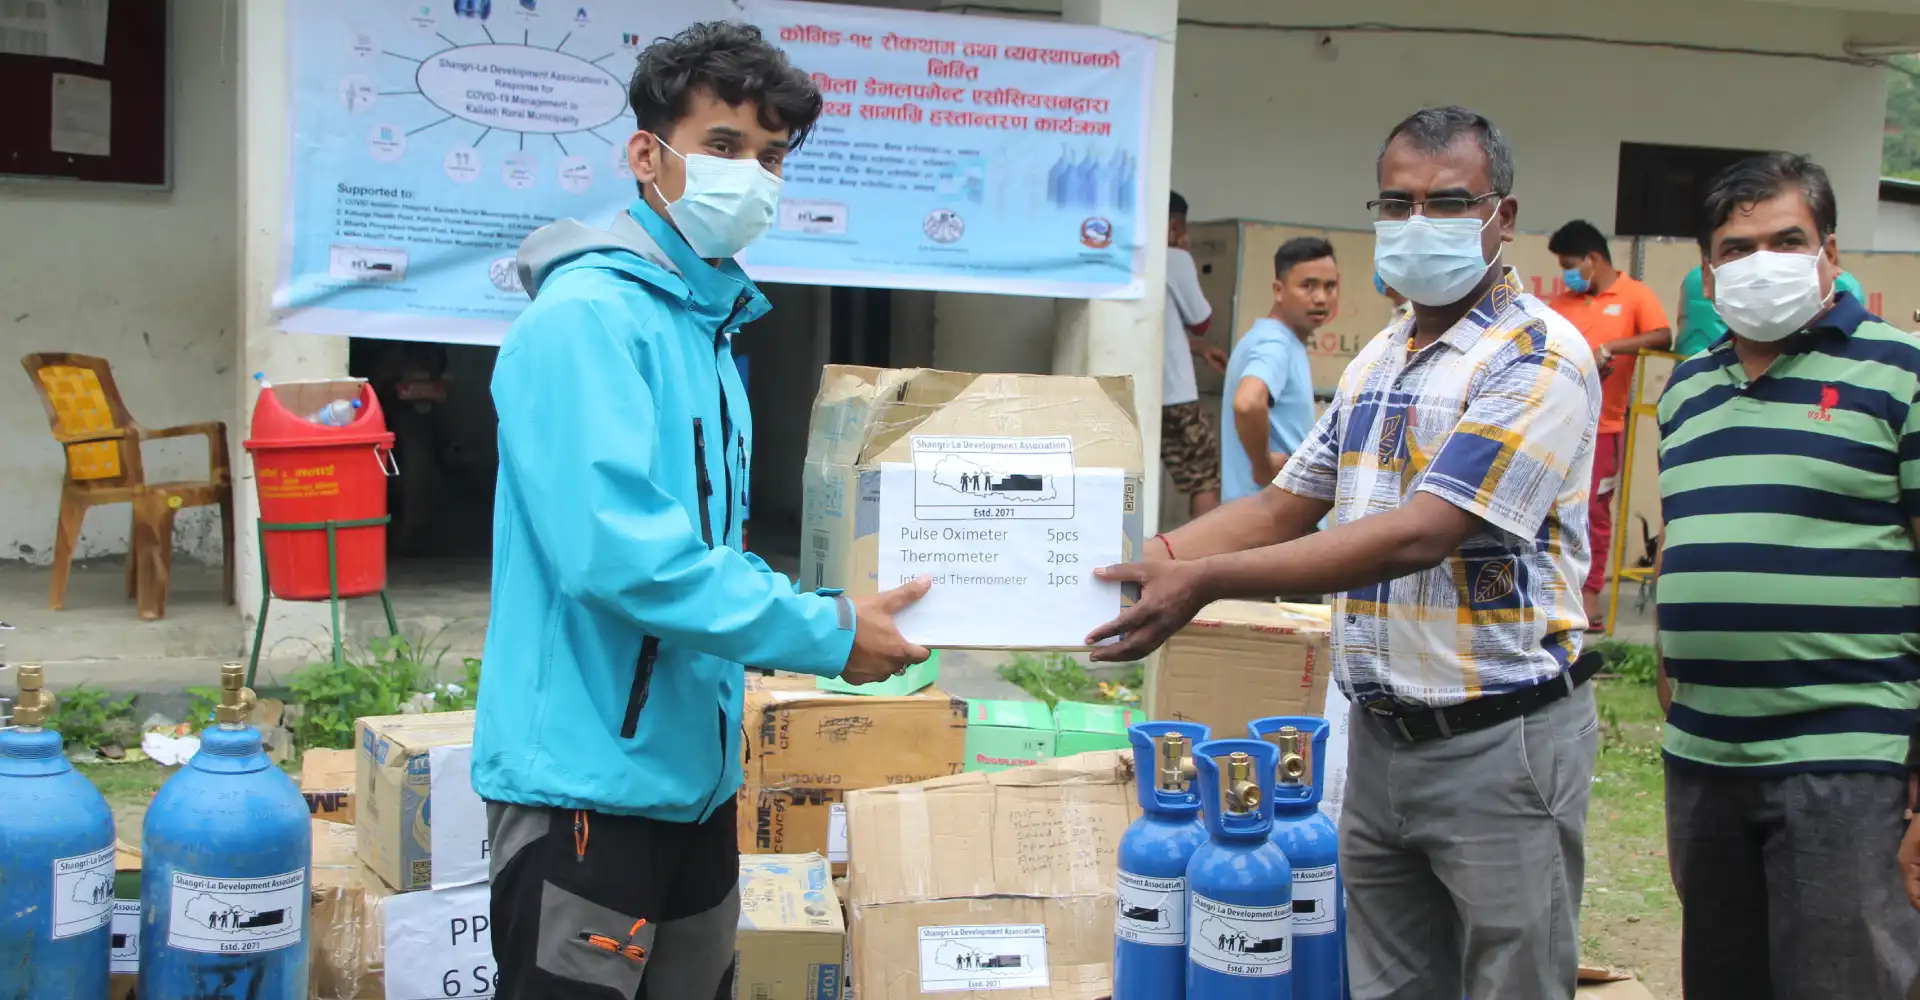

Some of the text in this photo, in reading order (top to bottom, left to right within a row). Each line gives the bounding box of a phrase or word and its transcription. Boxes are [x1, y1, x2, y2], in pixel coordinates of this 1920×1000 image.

[881, 32, 956, 55] रोकथाम
[963, 42, 998, 60] तथा
[439, 58, 488, 73] Shangri-La
[490, 65, 549, 80] Development
[494, 79, 554, 93] Response for
[466, 90, 510, 104] COVID-19
[511, 95, 568, 112] Management
[466, 104, 579, 126] Kailash Rural Municipality
[337, 183, 398, 198] Supported
[916, 439, 1066, 451] Shangri-La Development Association
[974, 508, 1015, 517] Estd. 2071
[901, 527, 1079, 544] Pulse Oximeter 5pcs
[900, 550, 1079, 565] Thermometer 2pcs
[949, 573, 1028, 585] Thermometer
[1048, 573, 1079, 587] 1pcs
[61, 857, 97, 871] Shangri-La
[1300, 870, 1333, 880] Association
[176, 875, 216, 890] Shangri-La
[218, 881, 270, 891] Development
[1144, 880, 1181, 889] Association
[1194, 896, 1226, 914] Shangri-La
[1227, 907, 1272, 918] Development
[923, 927, 1041, 937] Shangri-La Development Association
[220, 941, 260, 951] Estd. 2071
[1227, 964, 1263, 974] Estd. 2071
[443, 969, 461, 997] 6
[822, 965, 836, 997] TOP
[968, 980, 984, 988] Estd.
